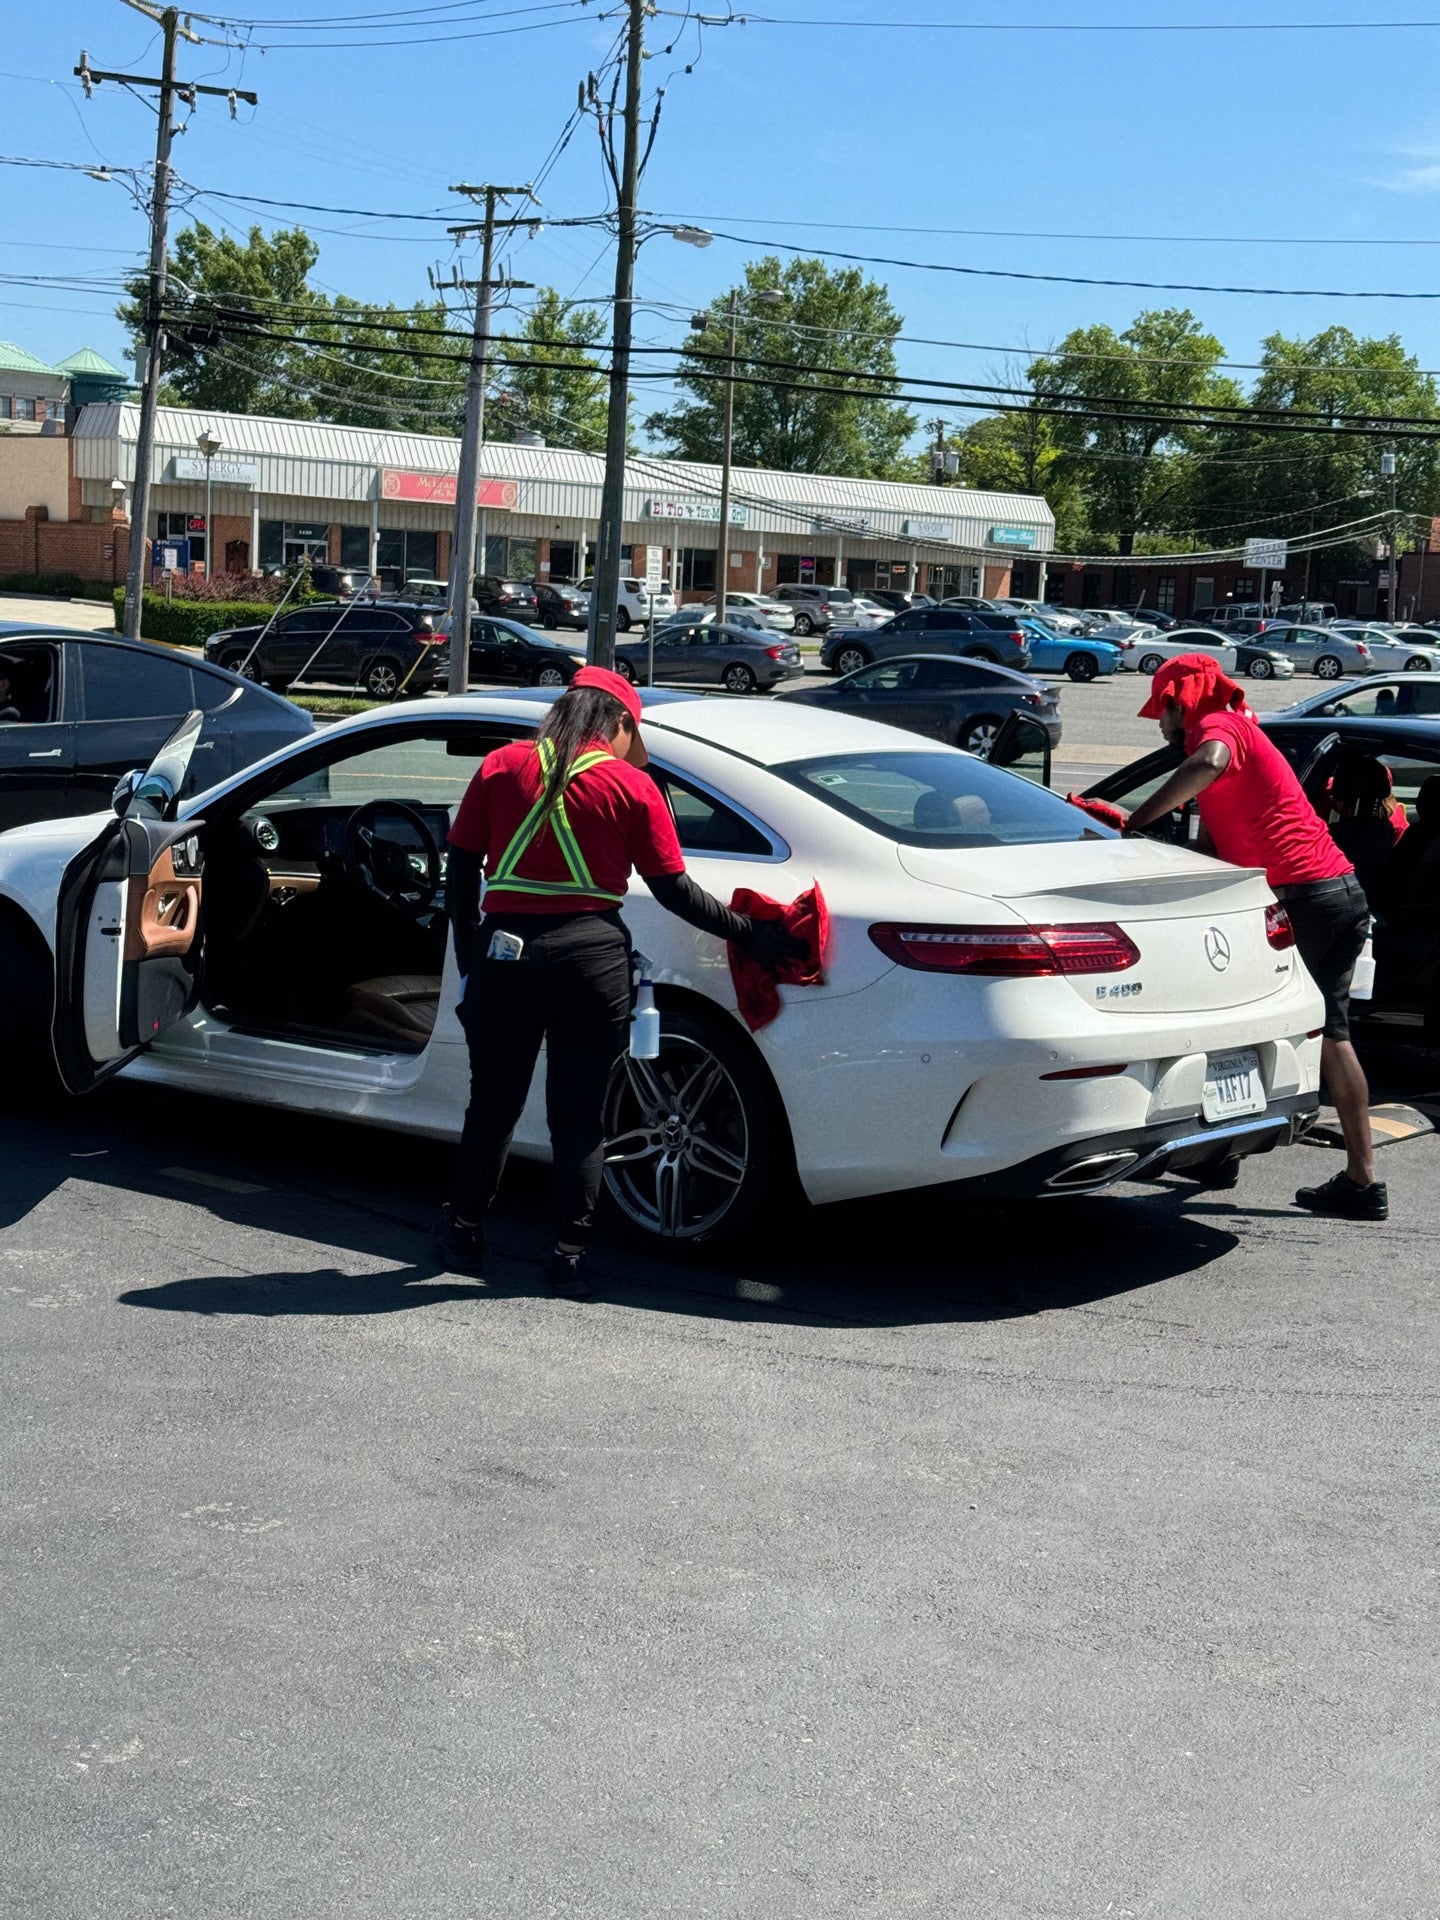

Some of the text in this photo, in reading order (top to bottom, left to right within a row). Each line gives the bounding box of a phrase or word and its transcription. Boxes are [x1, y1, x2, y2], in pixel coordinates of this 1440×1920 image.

[192, 460, 243, 474] SYNERGY
[653, 502, 664, 515] El
[667, 503, 684, 517] Tio
[1096, 985, 1107, 999] E
[1211, 1058, 1244, 1072] VIRGINIA
